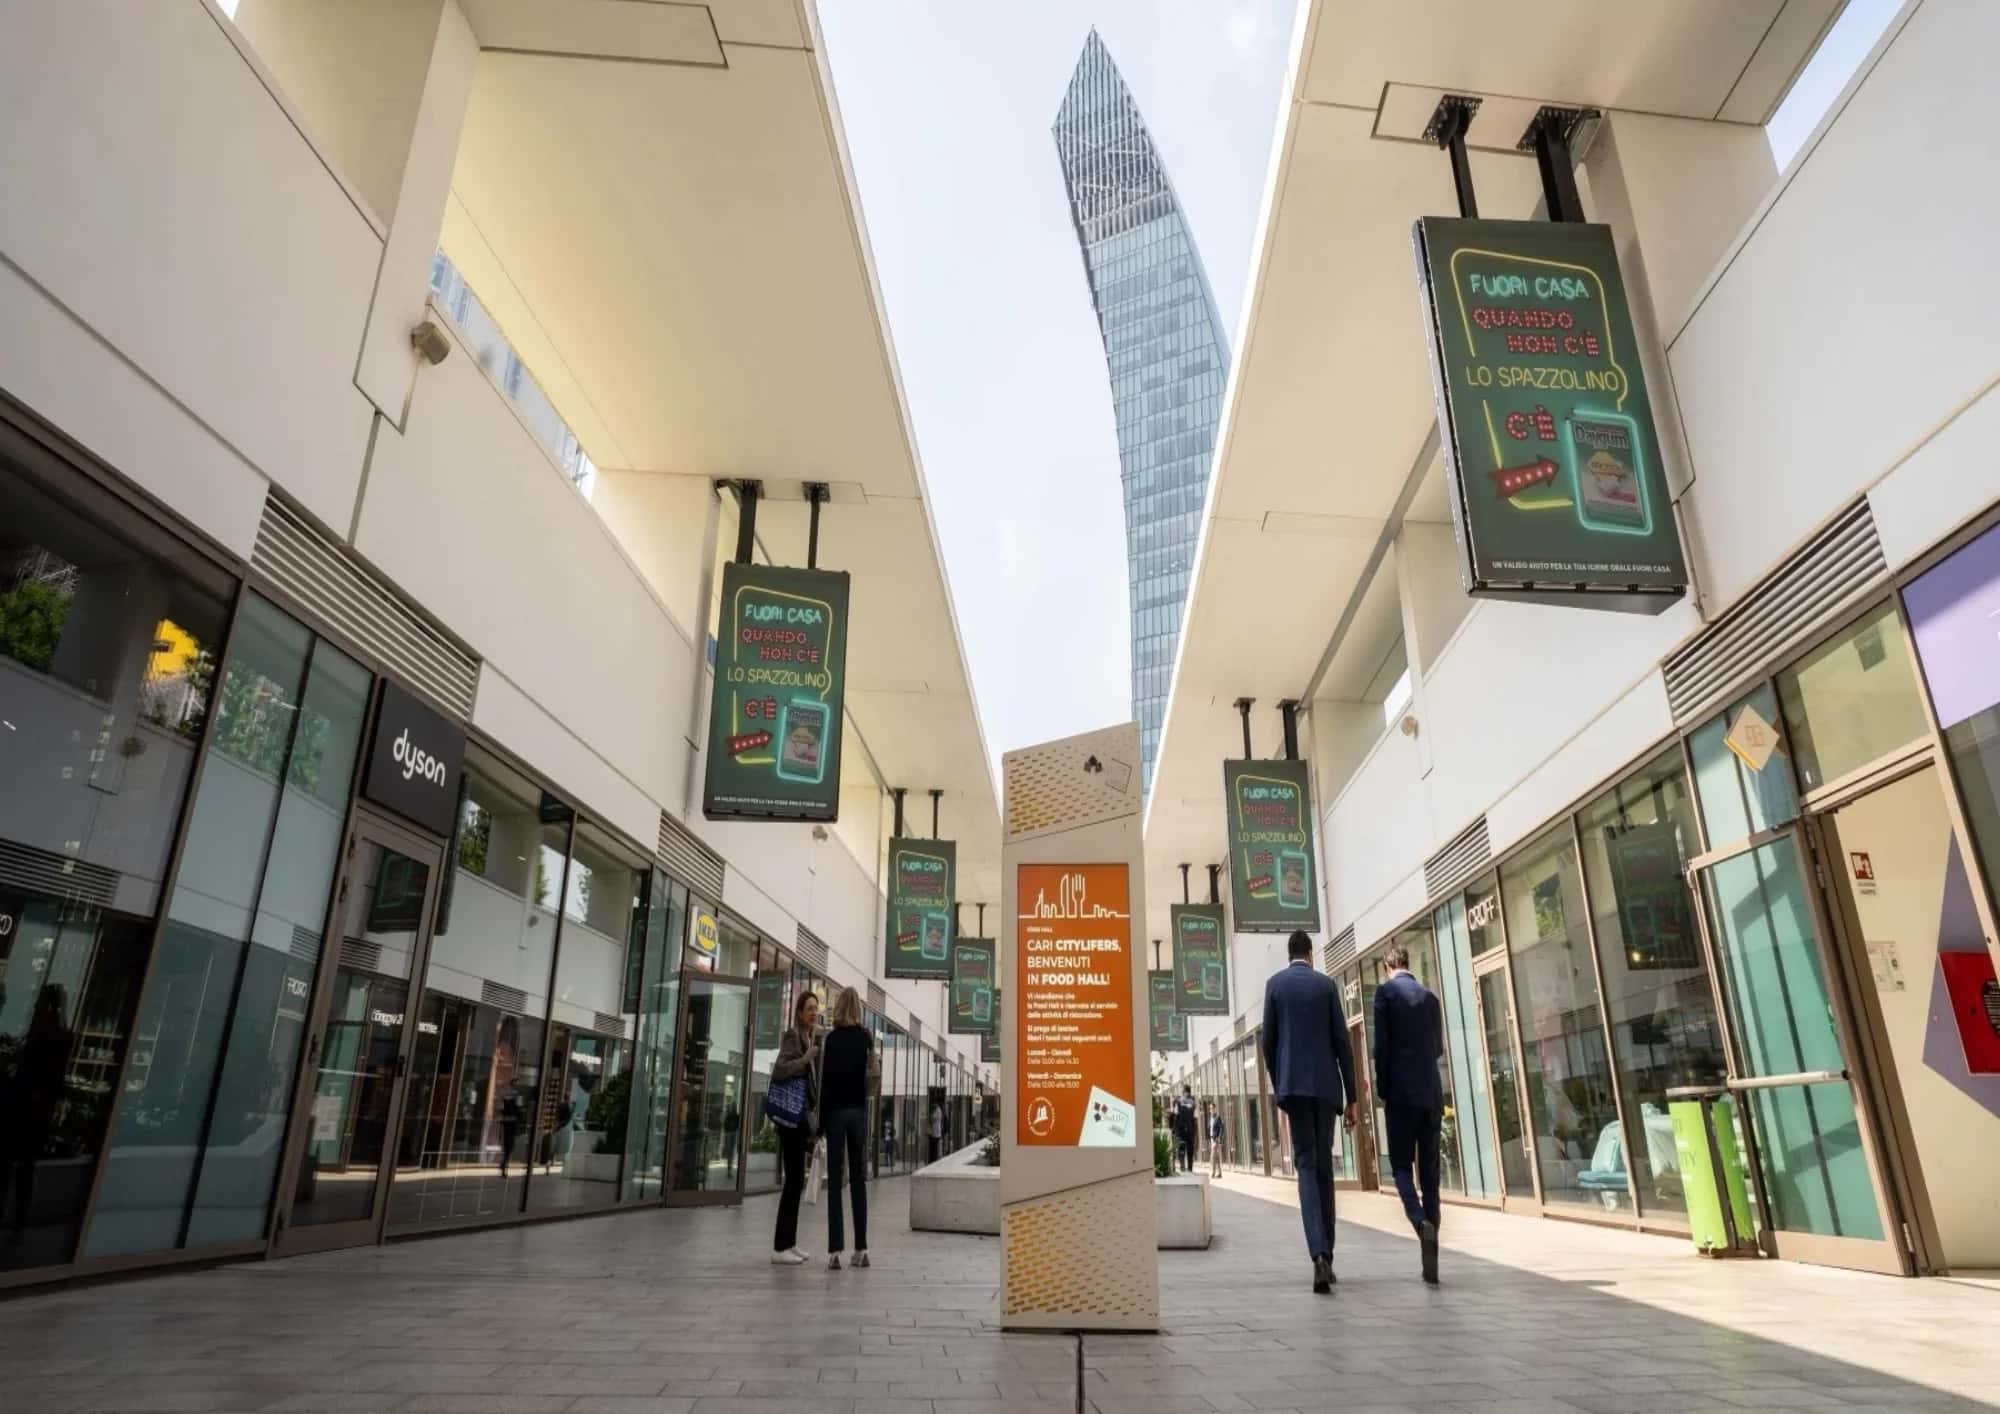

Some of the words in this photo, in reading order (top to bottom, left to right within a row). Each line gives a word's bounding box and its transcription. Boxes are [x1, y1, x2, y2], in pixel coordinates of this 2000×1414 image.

[1469, 274, 1528, 296] FUORI
[1535, 276, 1590, 299] CASA
[1472, 307, 1575, 330] QUANDO
[1506, 334, 1558, 354] NON
[1466, 366, 1492, 387] LO
[1497, 366, 1620, 392] SPAZZOLINO
[1505, 403, 1556, 440] C'È
[745, 604, 783, 621] FUORI
[787, 608, 822, 625] CASA
[741, 628, 807, 644] QUANDO
[759, 646, 792, 661] NON
[727, 667, 745, 682] LO
[747, 668, 826, 688] SPAZZOLINO
[393, 728, 446, 788] dyson
[1243, 787, 1269, 800] FUORI
[1271, 788, 1295, 800] CASA
[1027, 939, 1053, 951] CARI
[1055, 939, 1122, 953] CITYLIFERS,
[1027, 955, 1091, 969] BENVENUTI
[1027, 973, 1039, 985] IN
[1041, 973, 1075, 986] FOOD
[1077, 973, 1111, 986] HALL!
